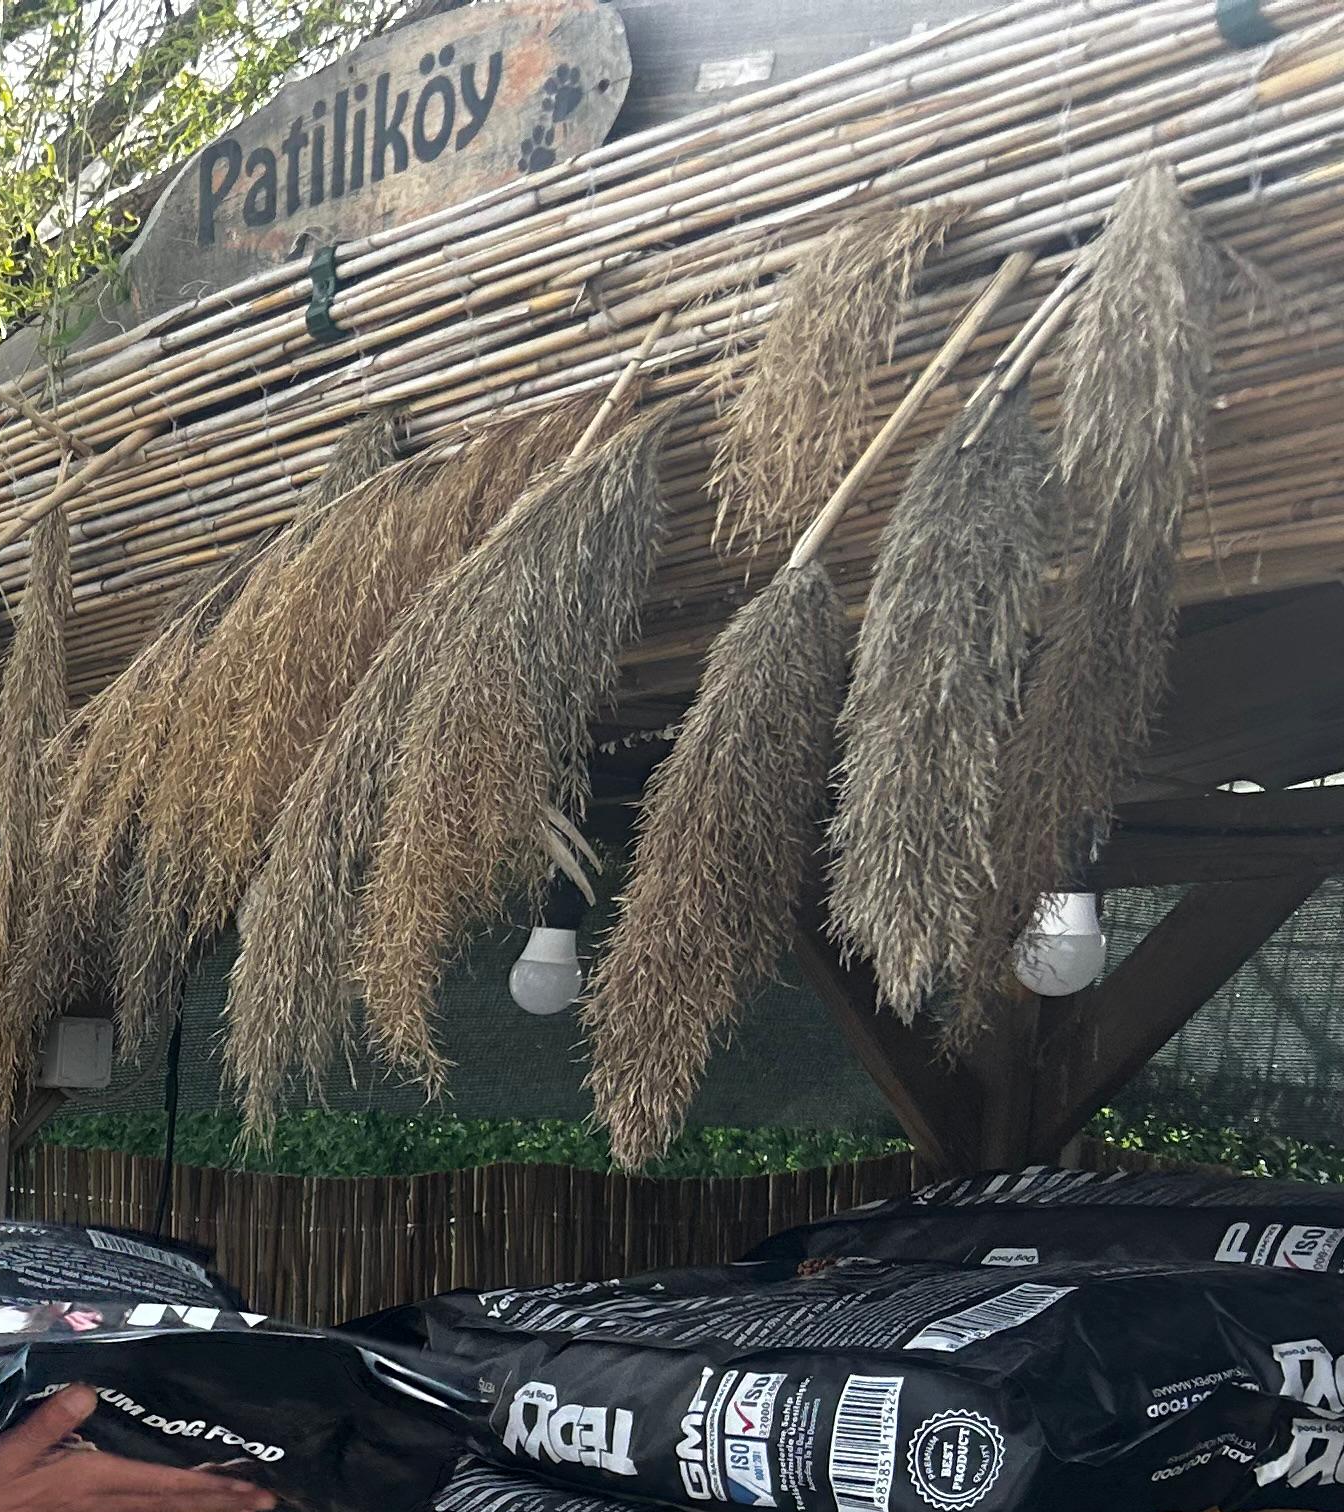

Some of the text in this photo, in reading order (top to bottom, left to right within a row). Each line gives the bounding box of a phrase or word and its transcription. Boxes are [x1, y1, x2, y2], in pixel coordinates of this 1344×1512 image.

[198, 44, 503, 248] Patiliköy
[1301, 1228, 1325, 1256] ISO
[749, 1376, 770, 1408] ISO
[1146, 1399, 1188, 1418] FOOD
[142, 1414, 206, 1437] DOG
[204, 1425, 286, 1462] FOOD
[503, 1382, 639, 1476] TEDYY
[730, 1443, 750, 1471] ISO
[875, 1452, 893, 1505] 683851
[926, 1435, 940, 1481] PREMIUM
[940, 1441, 954, 1478] BEST
[951, 1427, 971, 1493] PRODUCT
[973, 1444, 989, 1485] QUALITY
